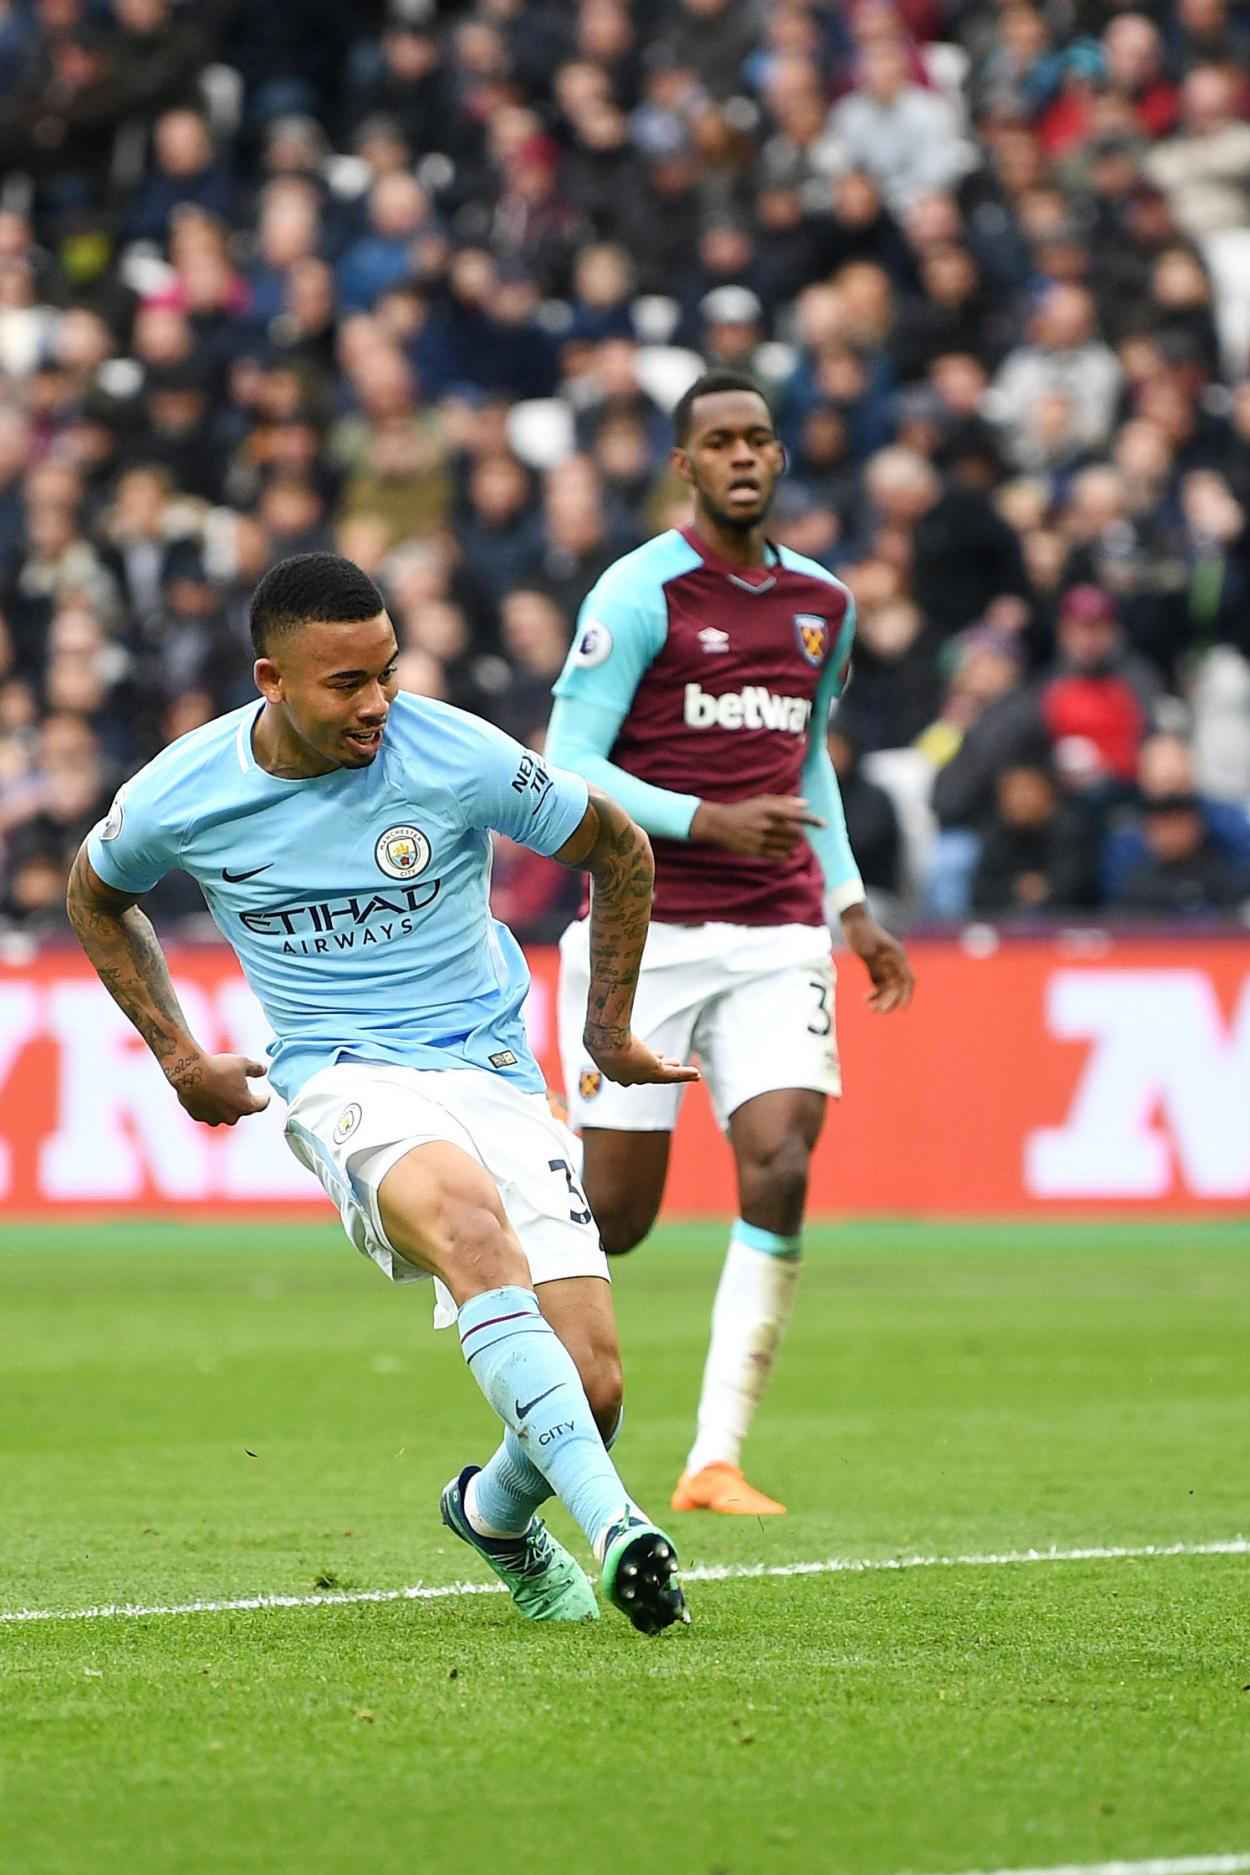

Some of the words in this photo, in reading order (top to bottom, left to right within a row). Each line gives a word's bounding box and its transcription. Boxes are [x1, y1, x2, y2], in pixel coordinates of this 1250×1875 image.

[380, 829, 423, 850] MANCHESTER
[400, 869, 416, 877] CITY
[238, 879, 441, 936] ETIHAD
[282, 917, 413, 954] AIRWAYS
[538, 1420, 575, 1446] CITY
